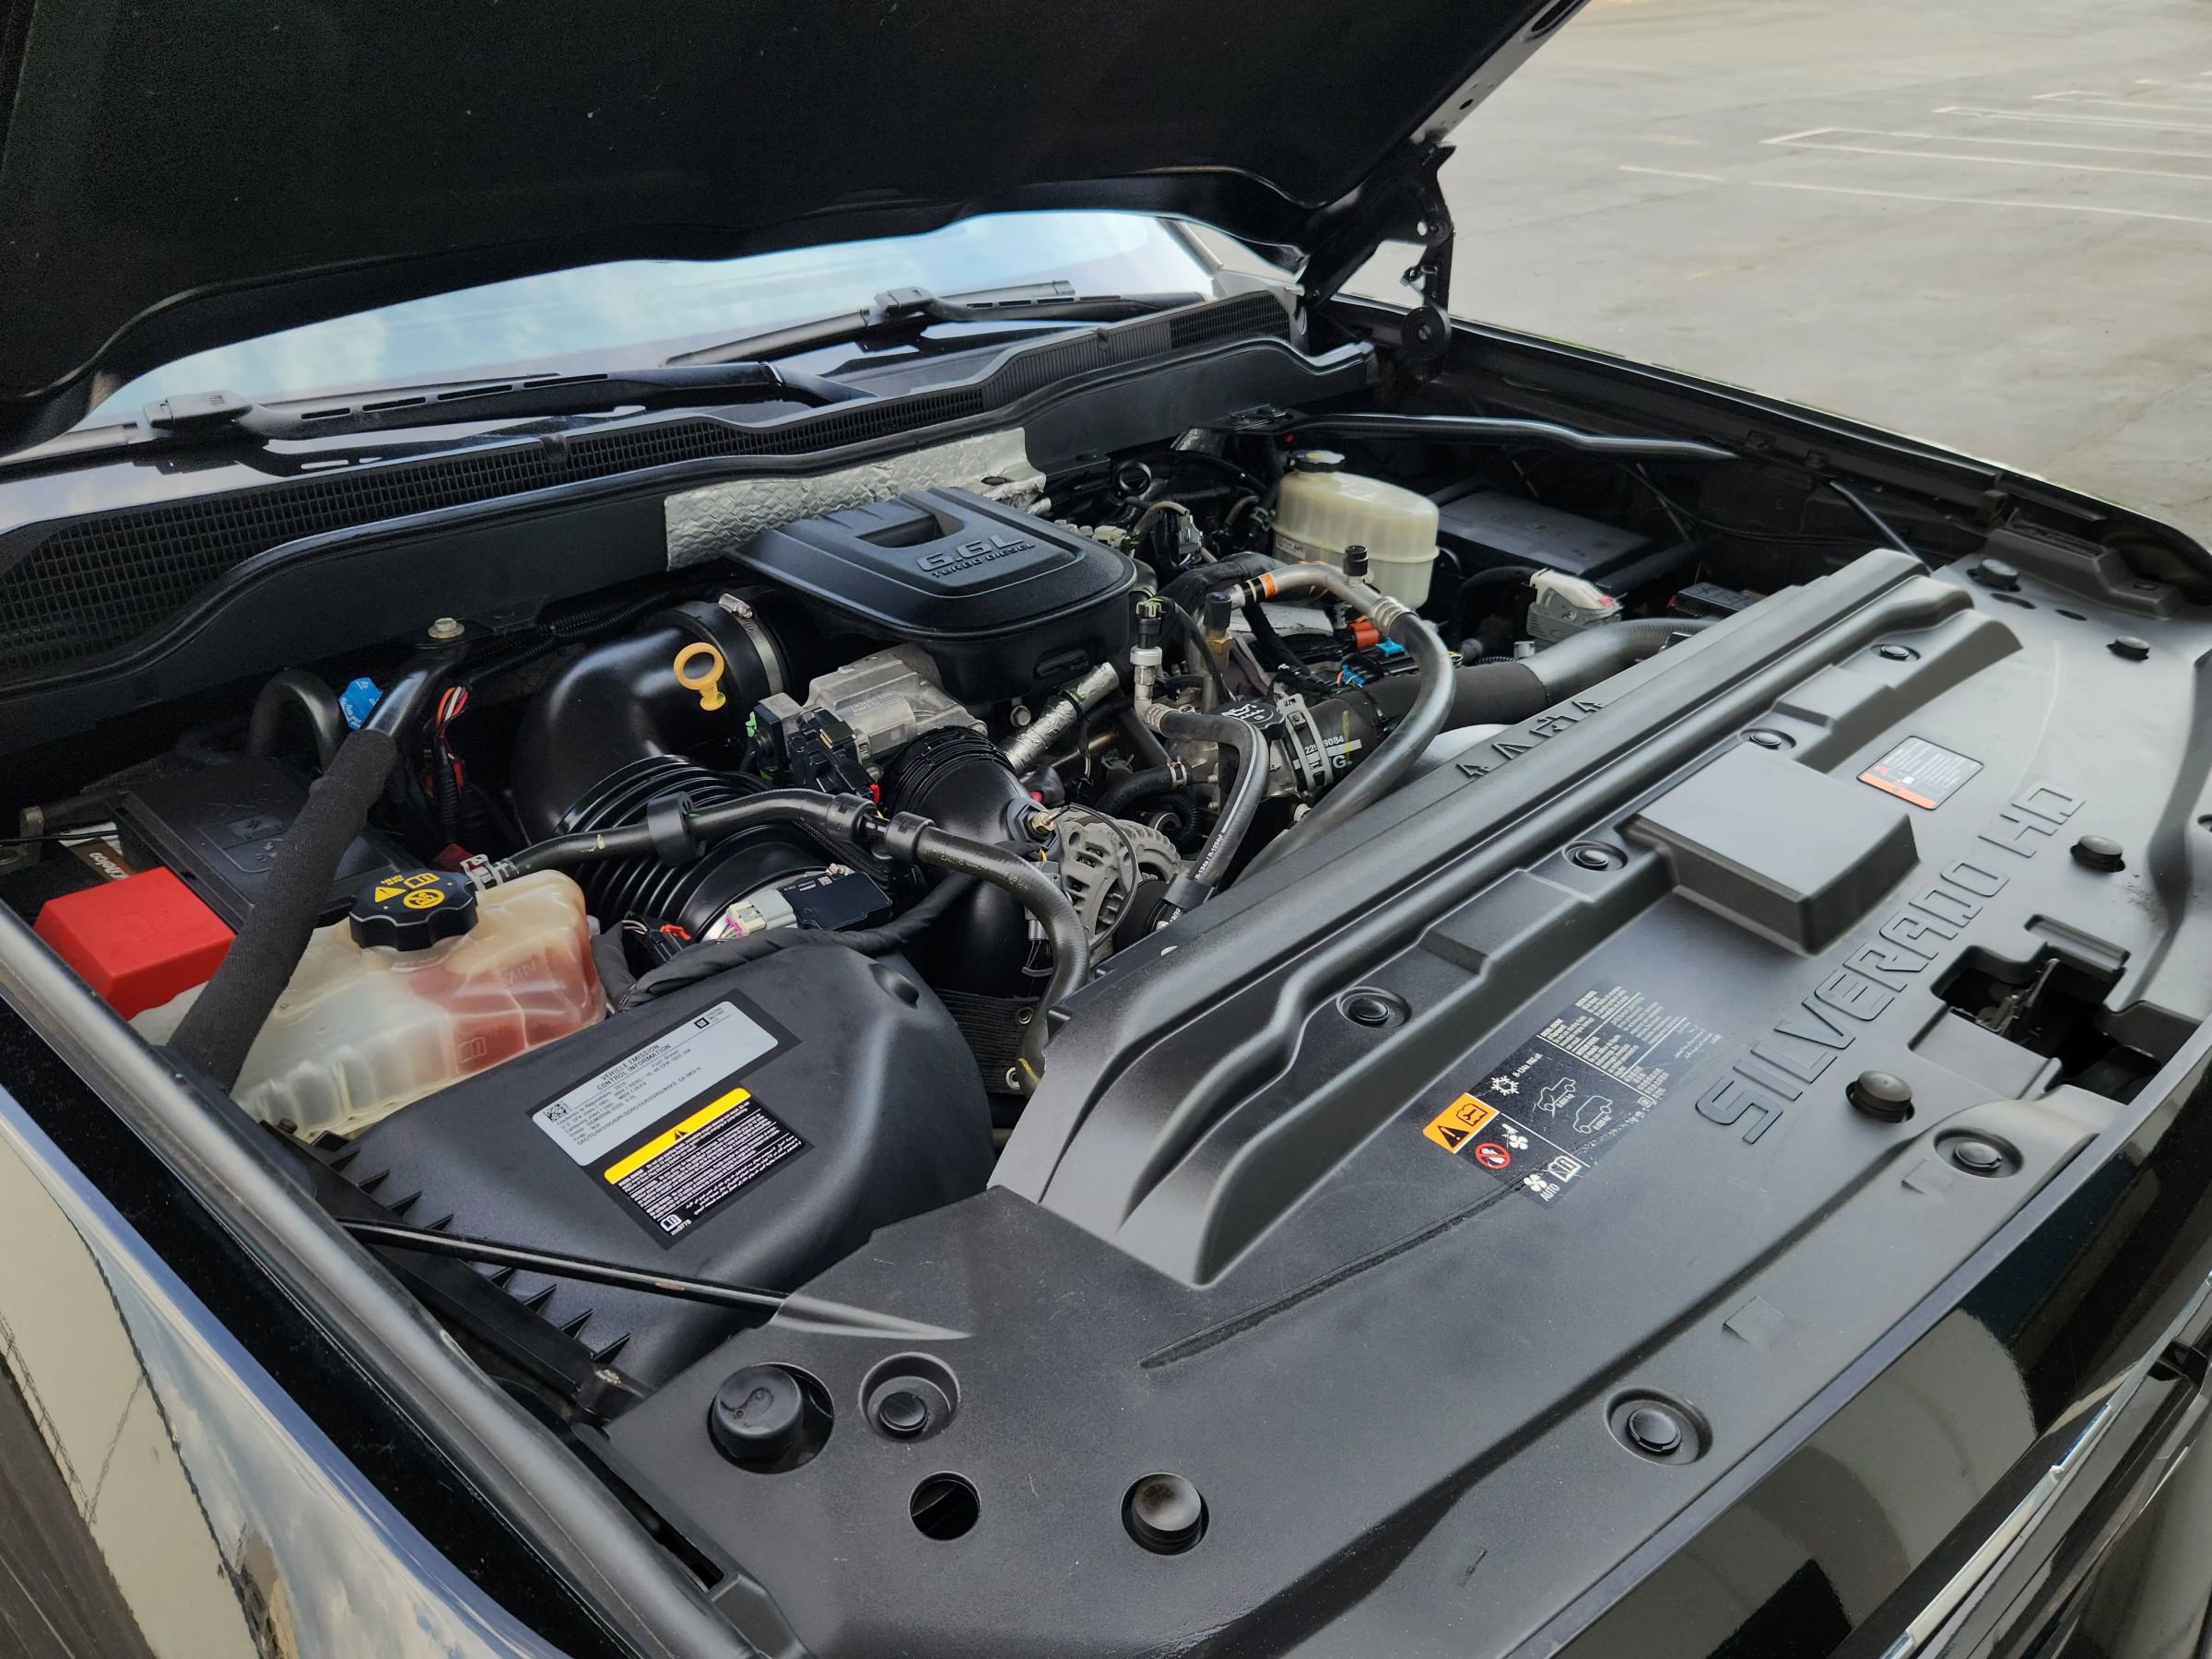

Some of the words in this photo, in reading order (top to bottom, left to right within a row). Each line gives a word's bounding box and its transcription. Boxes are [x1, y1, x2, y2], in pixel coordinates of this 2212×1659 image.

[916, 535, 1025, 571] 6.6L
[931, 558, 982, 578] TURBO
[985, 543, 1036, 562] DIESEL
[1695, 859, 2010, 1145] SILVERADO
[1977, 782, 2087, 858] HD
[595, 1070, 627, 1090] CONTROL
[626, 1042, 671, 1072] INFORMATION
[600, 1062, 628, 1081] VEHICLE
[628, 1043, 659, 1065] EMISSION
[1540, 1182, 1560, 1202] AUTO
